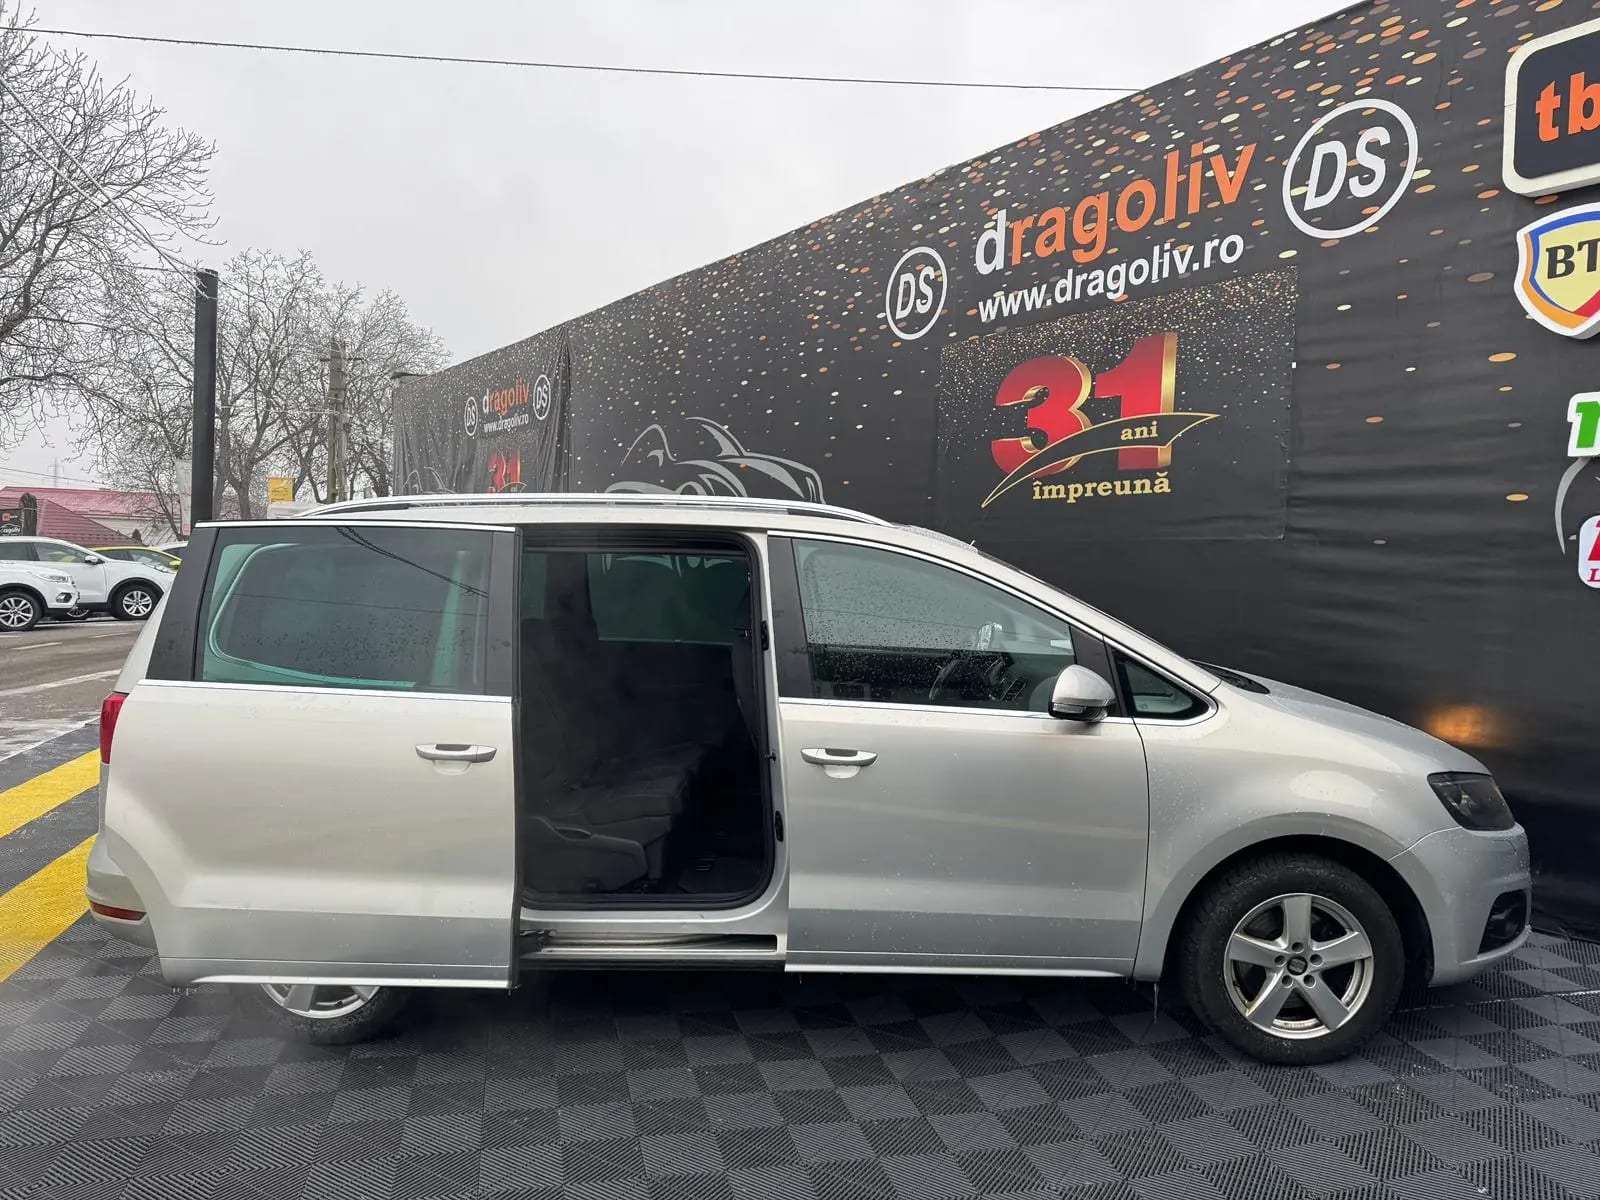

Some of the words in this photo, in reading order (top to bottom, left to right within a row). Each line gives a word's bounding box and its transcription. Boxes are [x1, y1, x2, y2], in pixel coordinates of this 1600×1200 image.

[1304, 127, 1390, 211] DS
[975, 142, 1257, 275] dragoliv
[978, 234, 1244, 322] www.dragoliv.ro
[1546, 238, 1600, 279] BT
[896, 266, 935, 319] DS
[482, 379, 530, 416] dragoliv
[536, 384, 548, 410] DS
[991, 332, 1178, 478] 31
[484, 413, 529, 433] www.dragoliv.ro
[1120, 421, 1158, 440] ani
[1032, 471, 1171, 503] împreună
